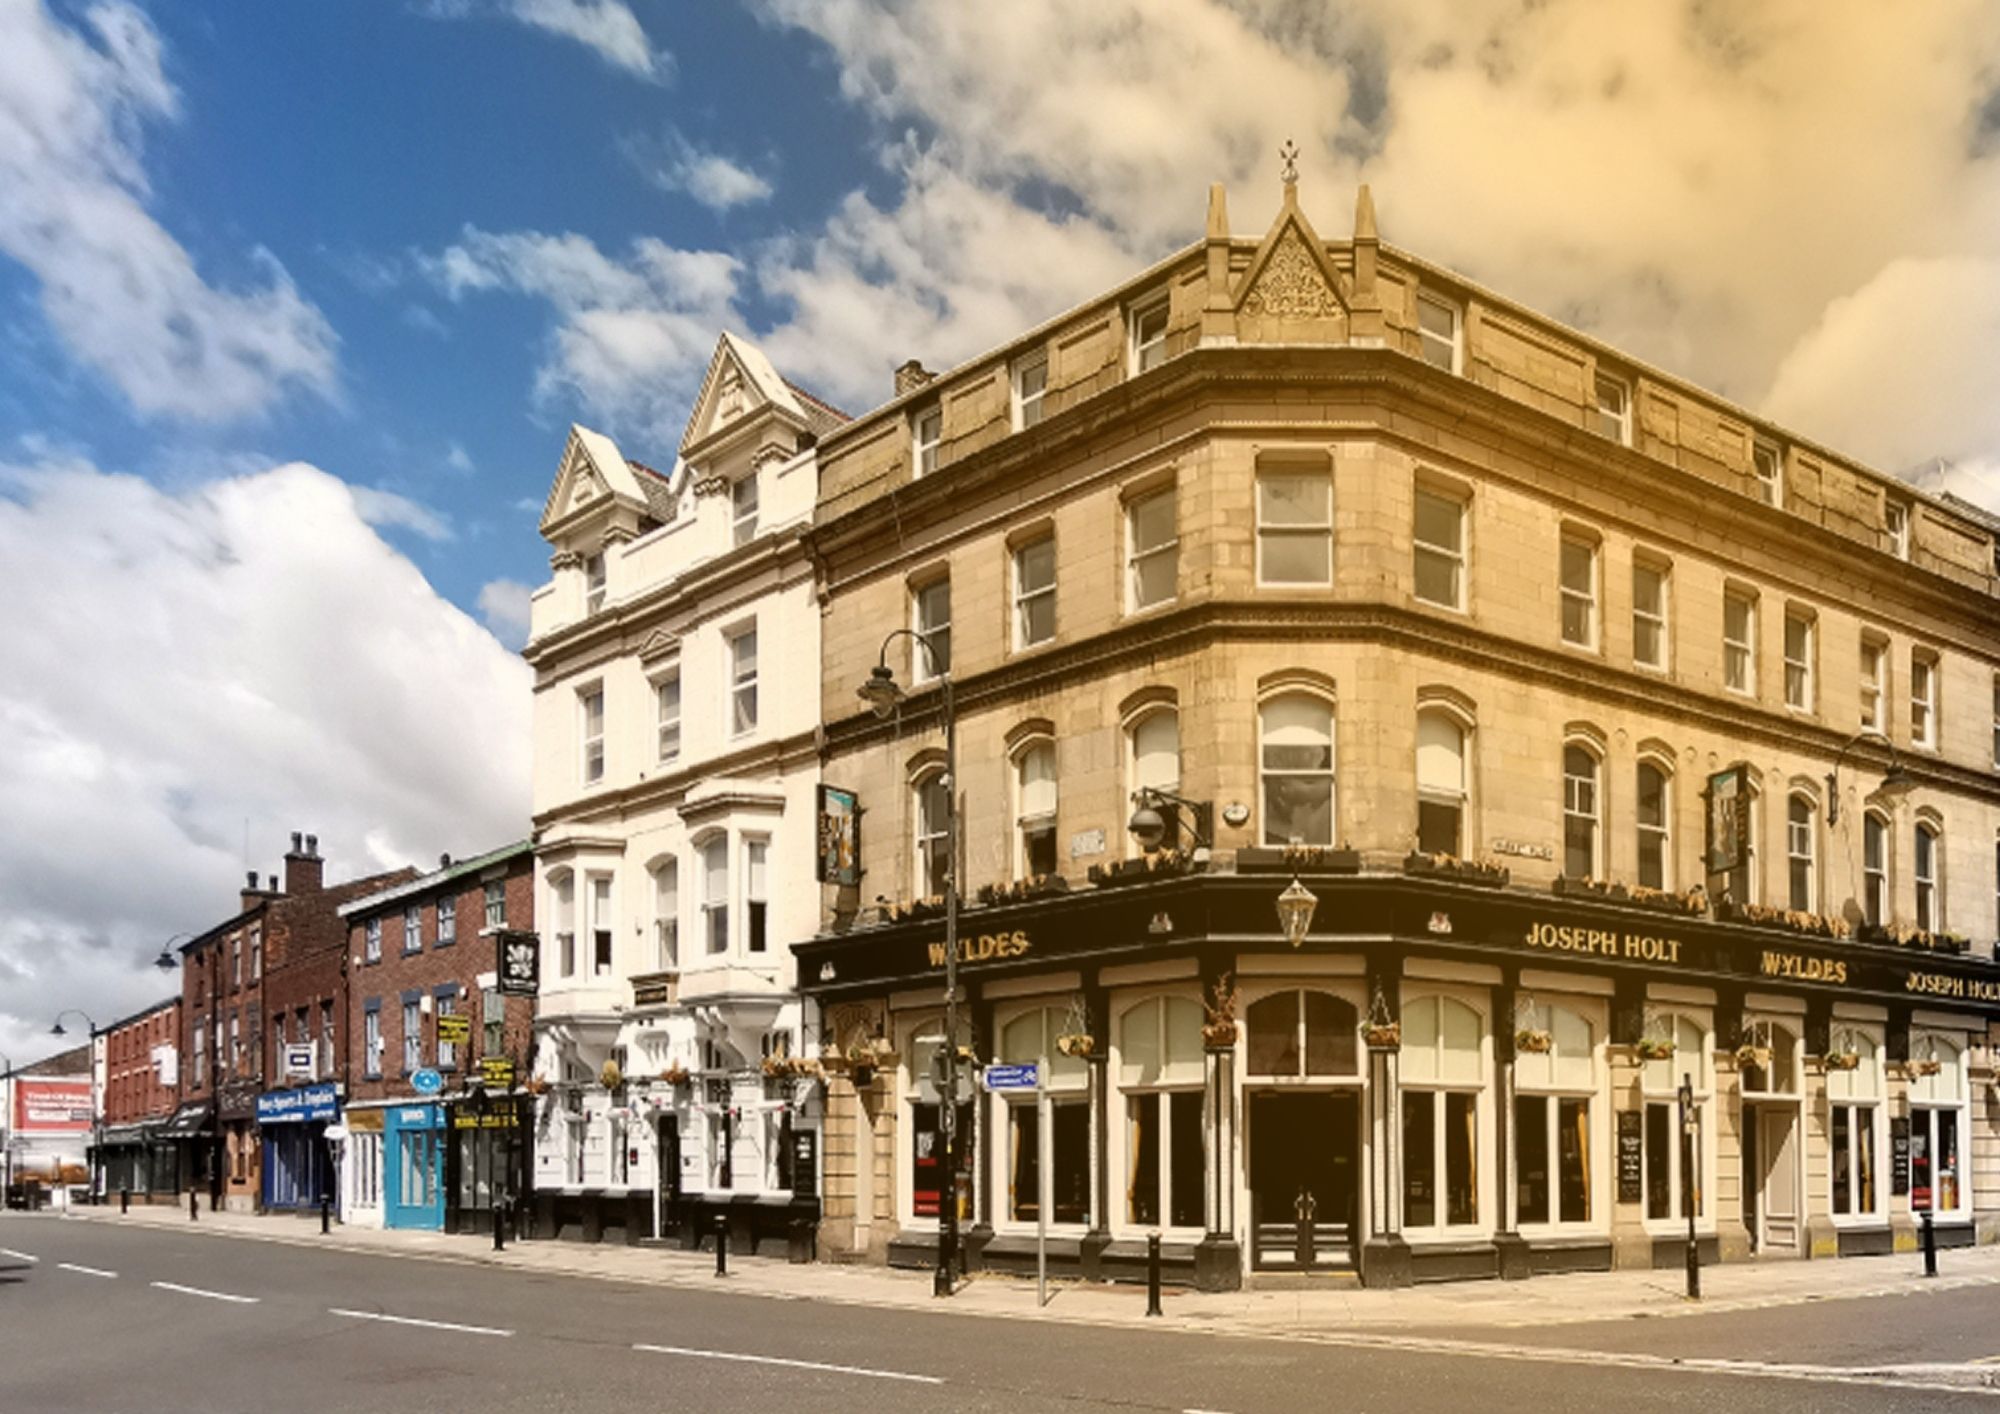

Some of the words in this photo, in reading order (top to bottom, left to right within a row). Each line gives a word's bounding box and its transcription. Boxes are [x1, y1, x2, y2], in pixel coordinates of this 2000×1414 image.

[1526, 922, 1617, 955] JOSEPH
[1624, 934, 1682, 962] HOLT
[1762, 951, 1847, 983] WYLDES
[1905, 971, 1964, 996] JOSEPH
[1968, 979, 2000, 1001] HOL
